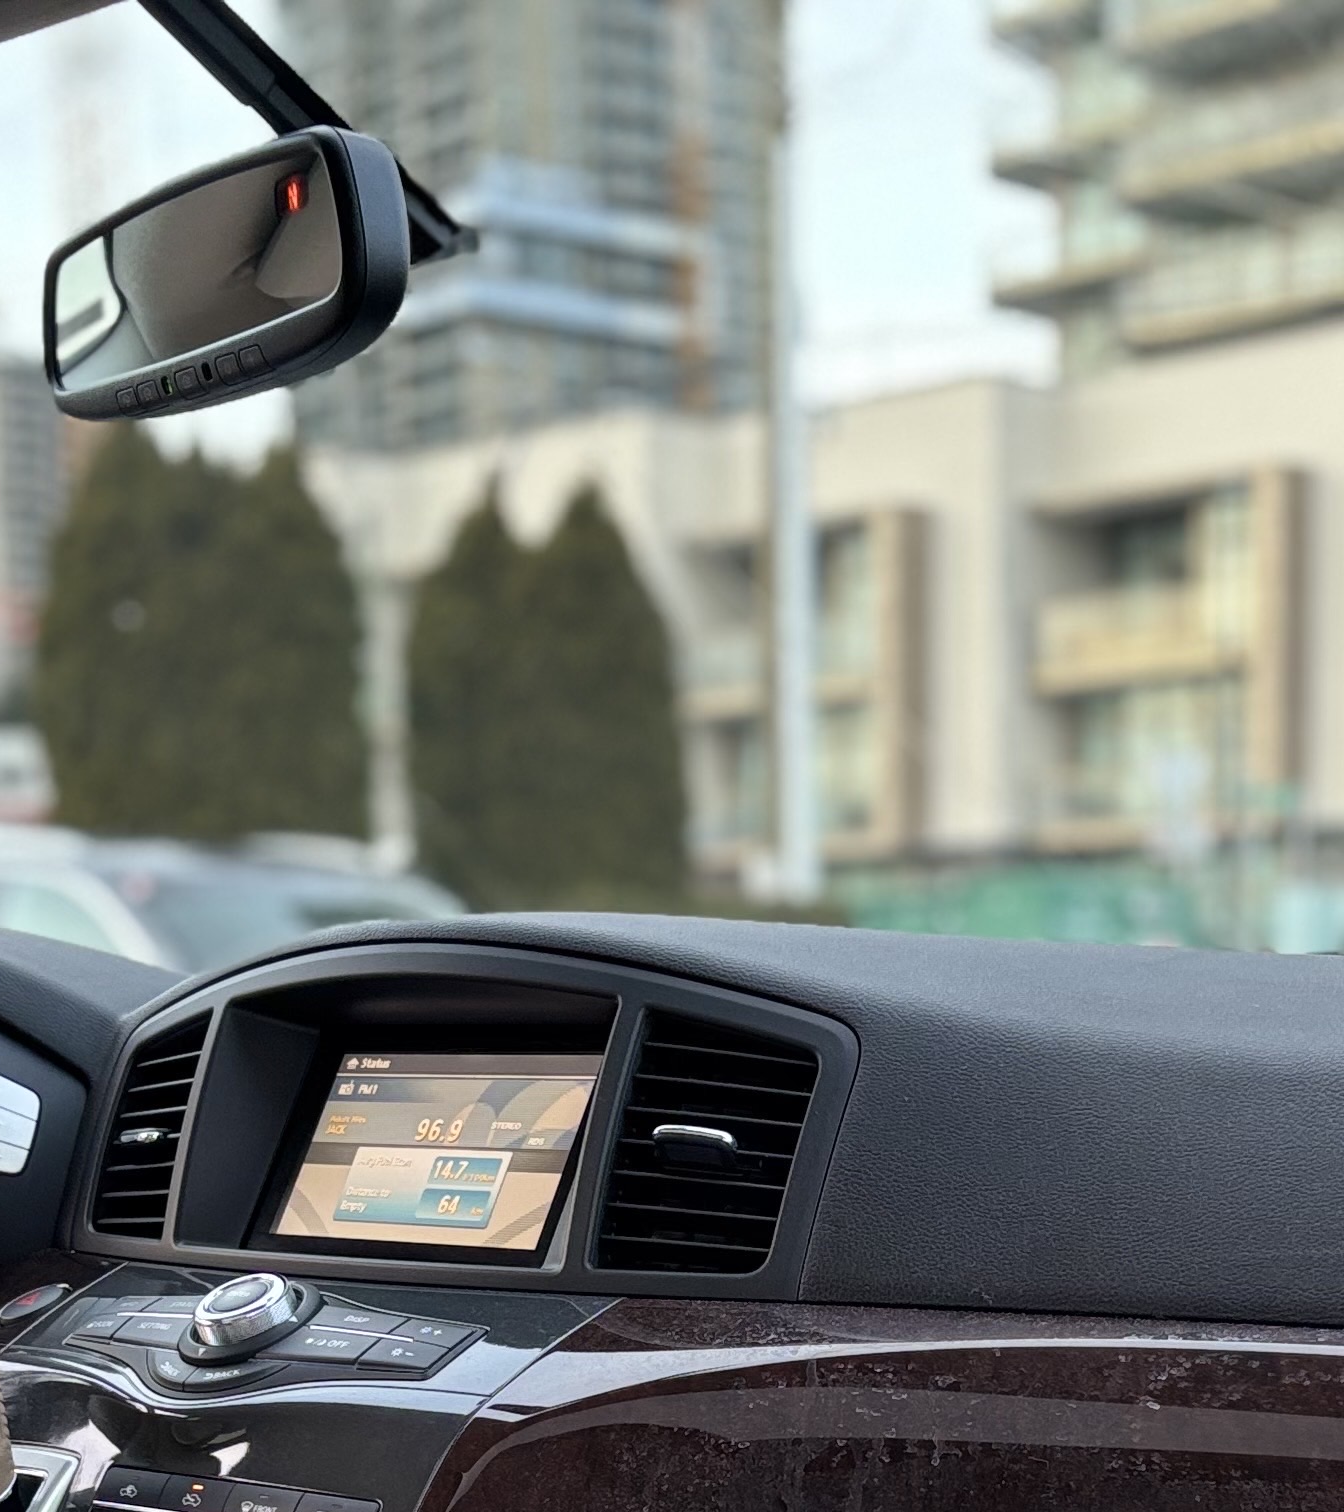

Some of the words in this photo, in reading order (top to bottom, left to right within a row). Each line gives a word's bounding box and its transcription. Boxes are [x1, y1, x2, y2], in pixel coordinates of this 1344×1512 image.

[360, 1057, 391, 1069] Status
[358, 1083, 379, 1095] FM1
[325, 1124, 347, 1135] JACK
[414, 1118, 464, 1143] 96.9
[491, 1121, 522, 1130] STEREO
[434, 1159, 469, 1180] 14.7
[340, 1200, 368, 1213] Empty
[437, 1194, 461, 1215] 64
[343, 1314, 371, 1324] DISP
[327, 1338, 351, 1349] OFF
[212, 1368, 242, 1379] BACK
